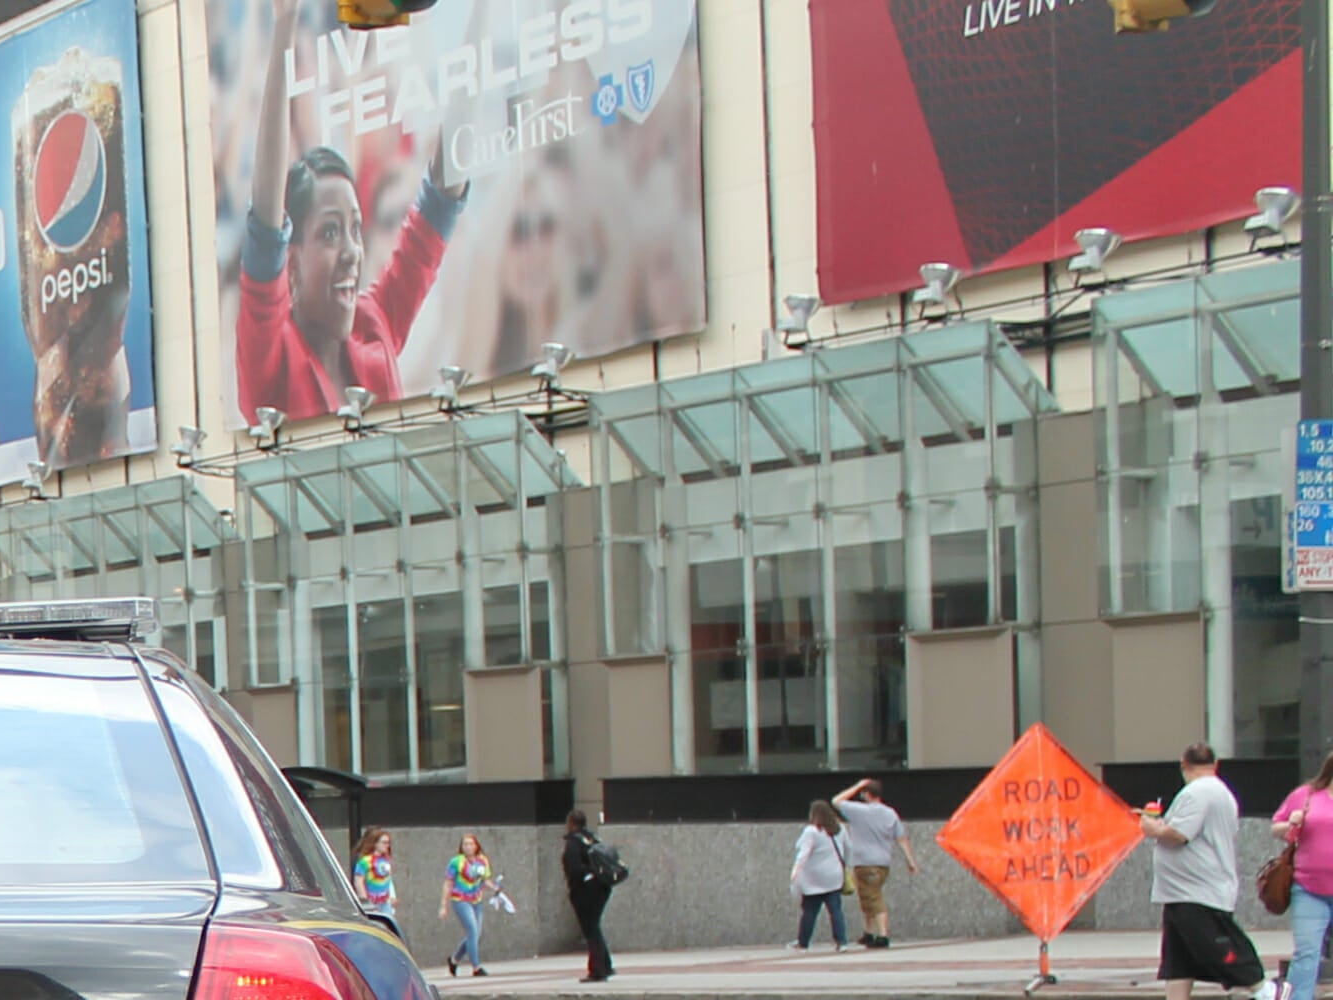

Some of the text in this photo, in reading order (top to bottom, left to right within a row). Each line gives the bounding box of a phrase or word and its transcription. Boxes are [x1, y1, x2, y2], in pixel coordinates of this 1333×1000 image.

[964, 0, 1021, 37] LIVE
[284, 25, 411, 99] LIVE
[319, 0, 653, 147] FEARLESS
[449, 90, 582, 174] CareFirst
[41, 247, 108, 313] pepsi
[1003, 777, 1081, 802] ROAD
[1003, 818, 1082, 842] WORK
[1003, 853, 1092, 883] AHEAD
